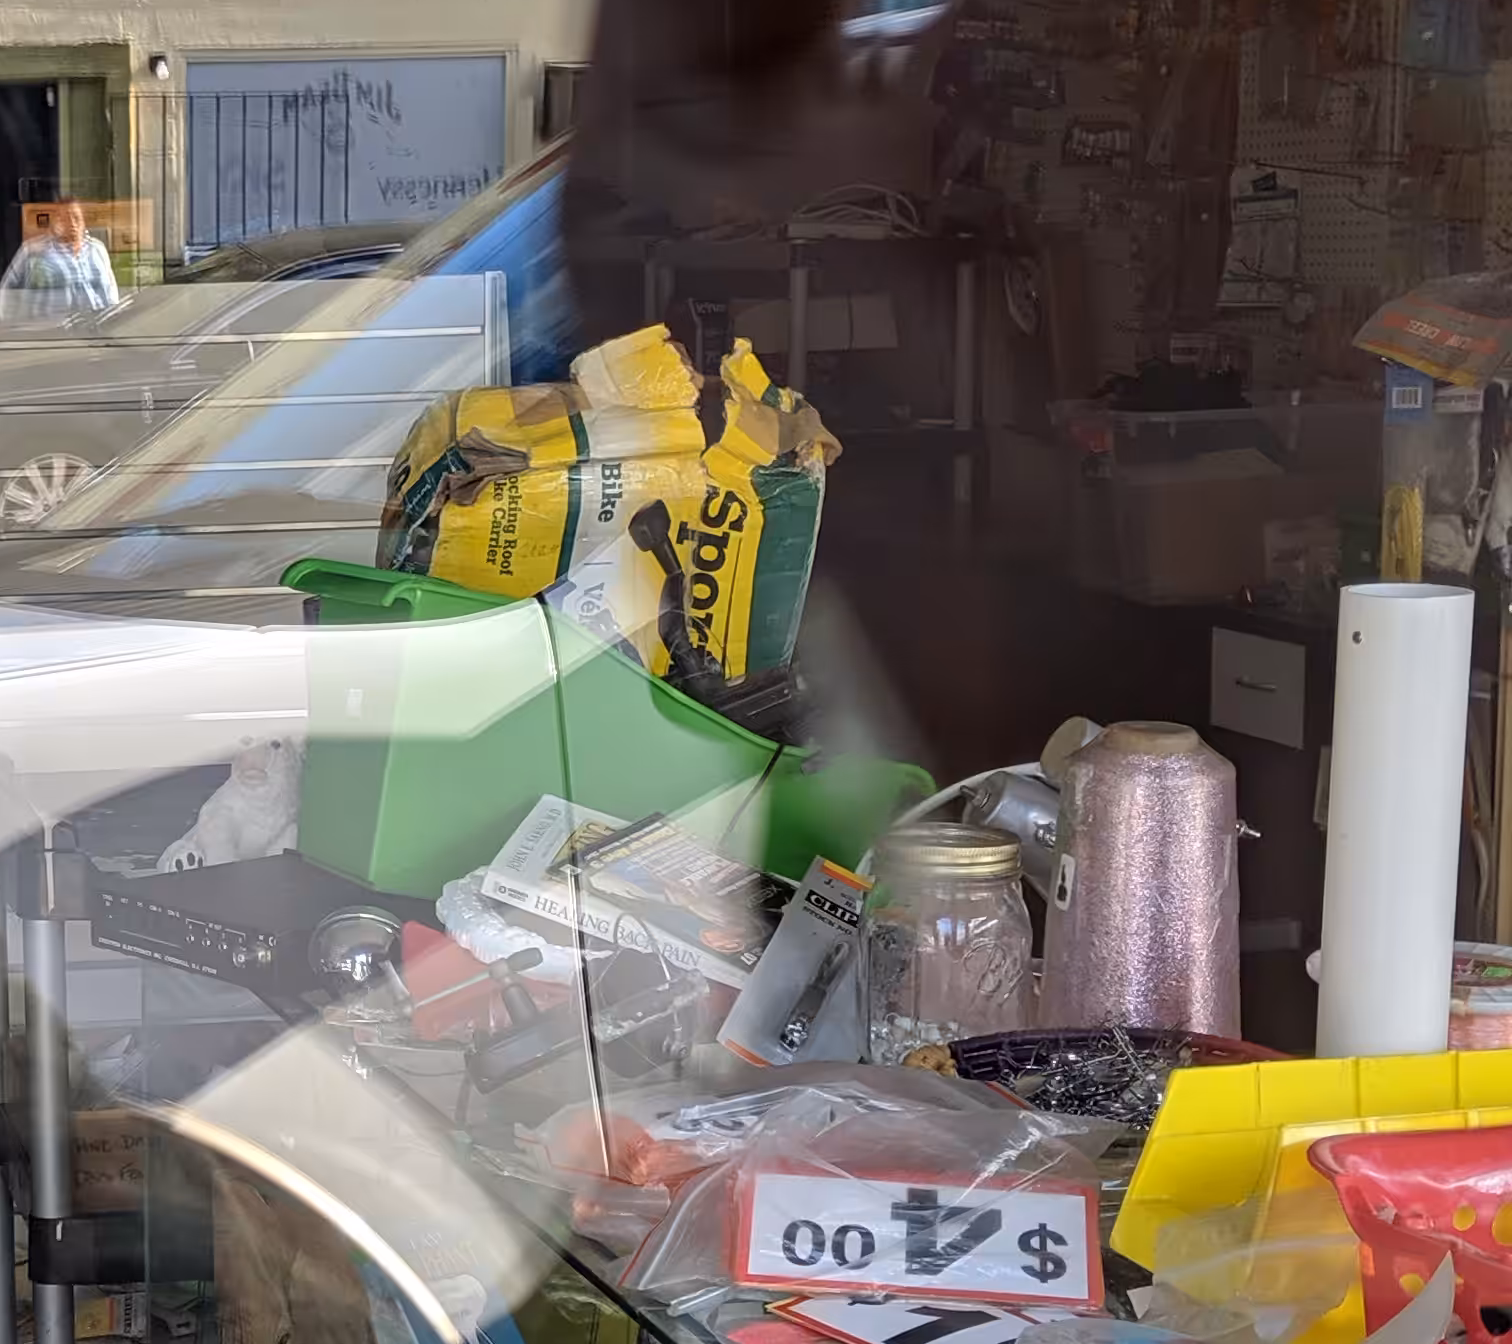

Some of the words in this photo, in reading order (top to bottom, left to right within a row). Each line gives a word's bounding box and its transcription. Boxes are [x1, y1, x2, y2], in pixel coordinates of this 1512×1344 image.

[502, 475, 523, 535] ocking
[597, 462, 623, 523] Bike
[485, 507, 506, 566] Carrier
[499, 538, 519, 577] Roof
[534, 895, 610, 934] HEAING
[662, 944, 702, 969] PAIN
[809, 894, 858, 922] CLIP
